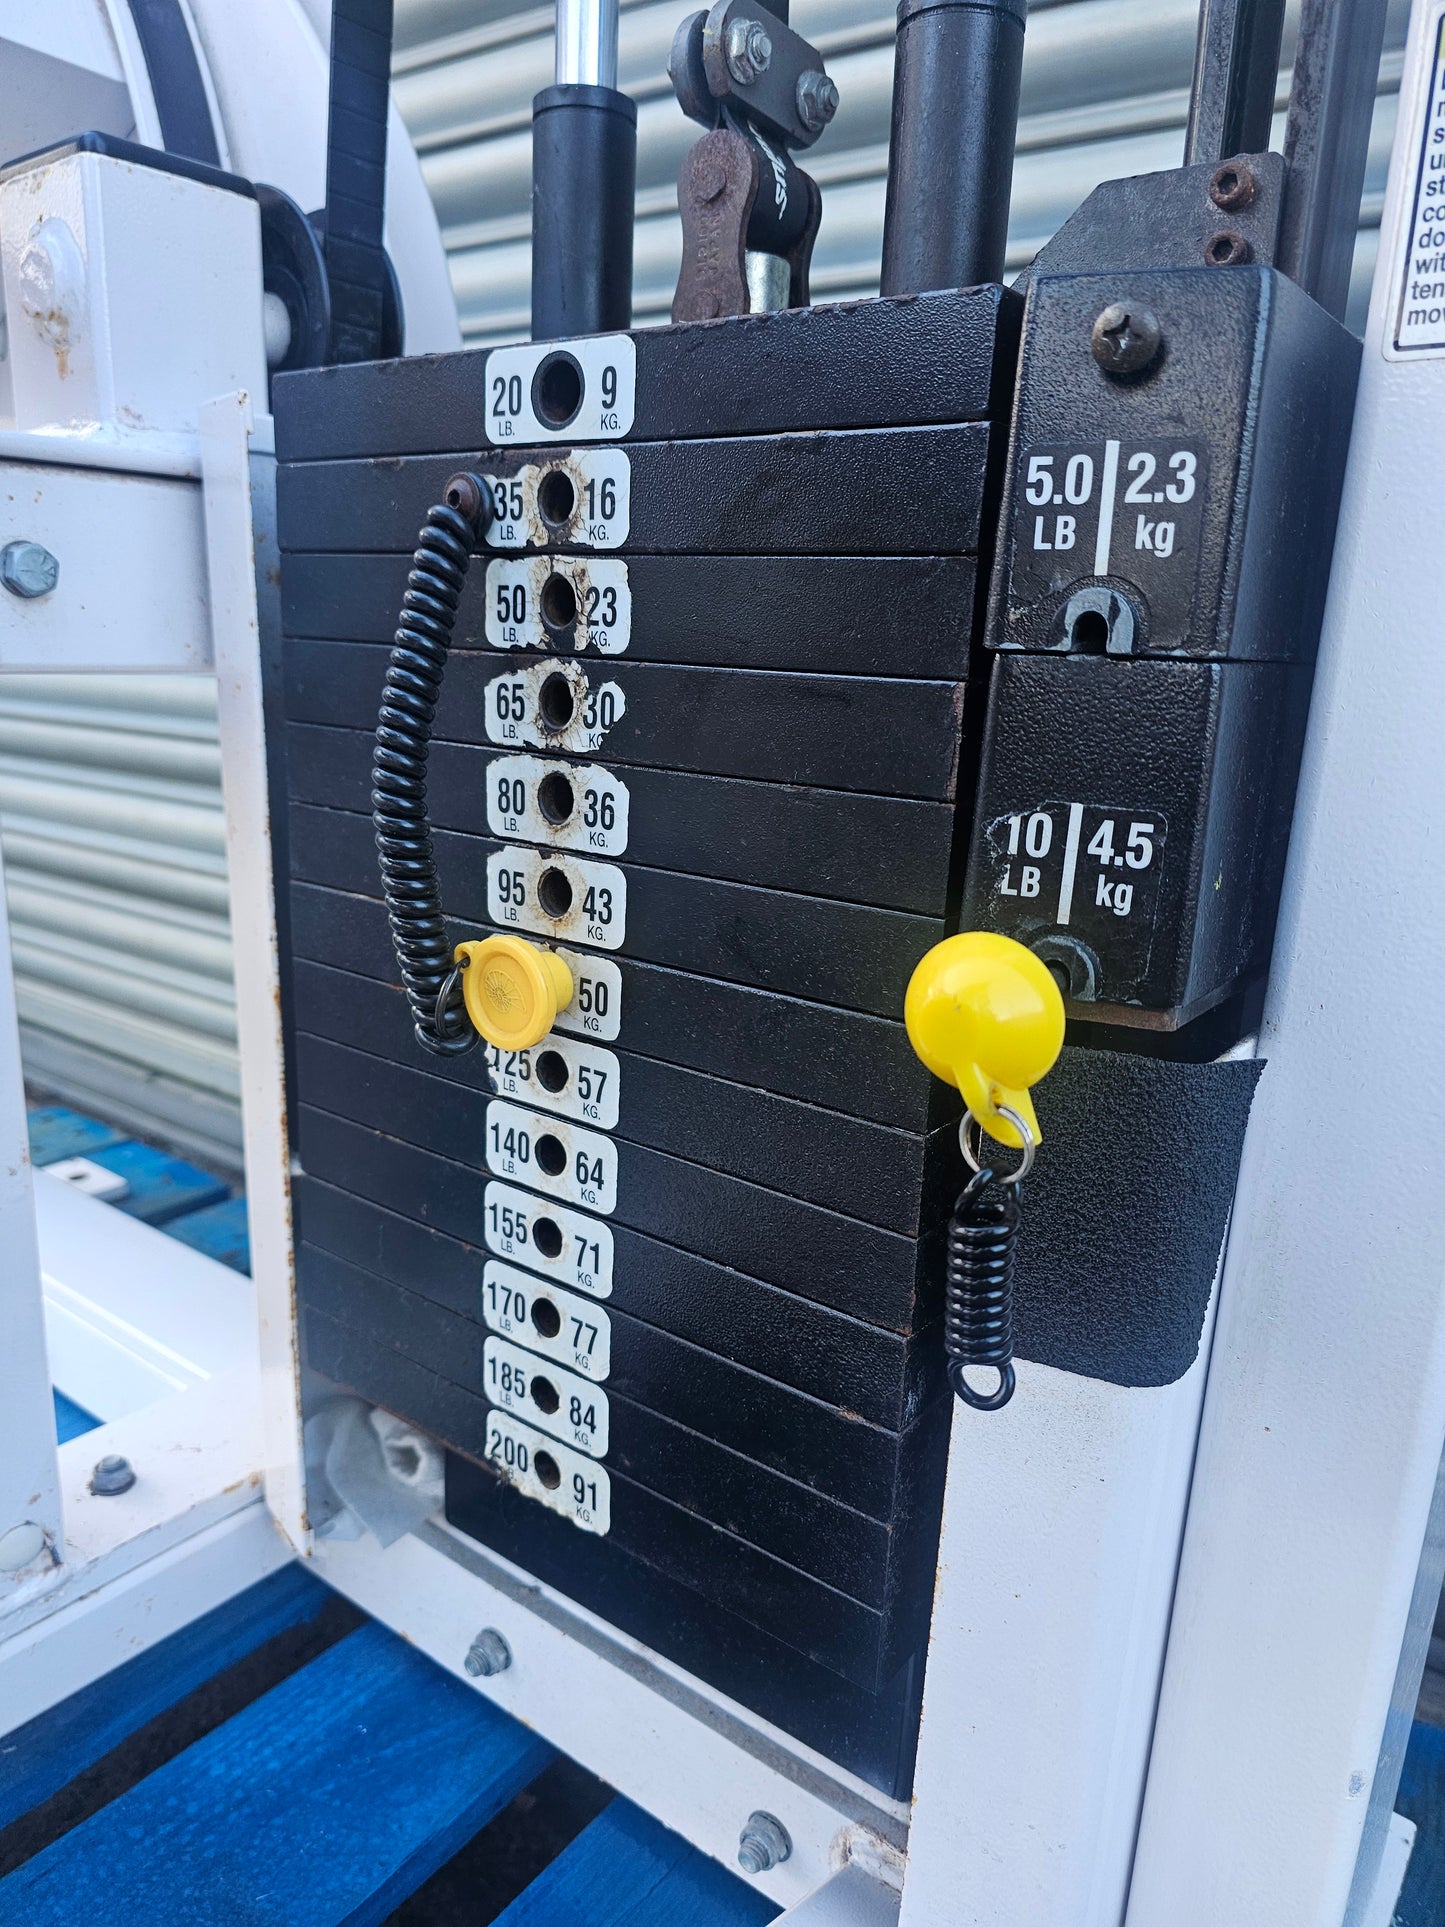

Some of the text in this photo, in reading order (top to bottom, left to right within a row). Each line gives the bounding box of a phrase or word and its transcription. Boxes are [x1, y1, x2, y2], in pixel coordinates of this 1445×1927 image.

[492, 374, 522, 417] 20
[601, 365, 617, 410] 9
[498, 420, 516, 437] LB.
[600, 413, 621, 431] KG.
[1025, 453, 1094, 506] 5.0
[1124, 450, 1197, 504] 2.3
[494, 480, 524, 521] 35
[583, 477, 616, 521] 16
[500, 525, 517, 541] LB.
[589, 524, 609, 541] KG.
[1033, 514, 1076, 551] LB
[1135, 513, 1176, 559] kg
[496, 583, 526, 624] 50
[584, 586, 617, 628] 23
[503, 627, 519, 643] LB.
[588, 629, 611, 648] KG.
[496, 682, 525, 722] 65
[583, 690, 615, 731] 30
[503, 724, 519, 740] LB.
[498, 777, 526, 816] 80
[584, 788, 615, 831] 36
[504, 816, 520, 833] LB.
[589, 831, 609, 848] KG.
[1007, 812, 1053, 859] 10
[1087, 819, 1155, 870] 4.5
[498, 868, 526, 907] 95
[1000, 863, 1042, 899] LB
[1095, 873, 1134, 917] kg
[504, 907, 520, 923] LB.
[582, 885, 613, 925] 43
[587, 925, 606, 942] KG.
[578, 976, 609, 1017] 50
[583, 1015, 602, 1033] KG.
[503, 1078, 519, 1094] LB.
[577, 1064, 608, 1105] 57
[582, 1103, 601, 1120] KG.
[490, 1122, 530, 1164] 140
[502, 1158, 517, 1175] LB.
[575, 1150, 605, 1191] 64
[580, 1187, 599, 1206] KG.
[488, 1202, 528, 1244] 155
[500, 1238, 516, 1255] LB.
[574, 1234, 600, 1275] 71
[577, 1270, 595, 1289] KG.
[487, 1280, 526, 1324] 170
[570, 1316, 599, 1356] 77
[488, 1356, 526, 1399] 185
[575, 1351, 592, 1372] KG.
[569, 1395, 597, 1435] 84
[490, 1428, 528, 1474] 200
[574, 1428, 592, 1447] KG.
[573, 1472, 598, 1512] 91
[576, 1504, 593, 1525] KG.
